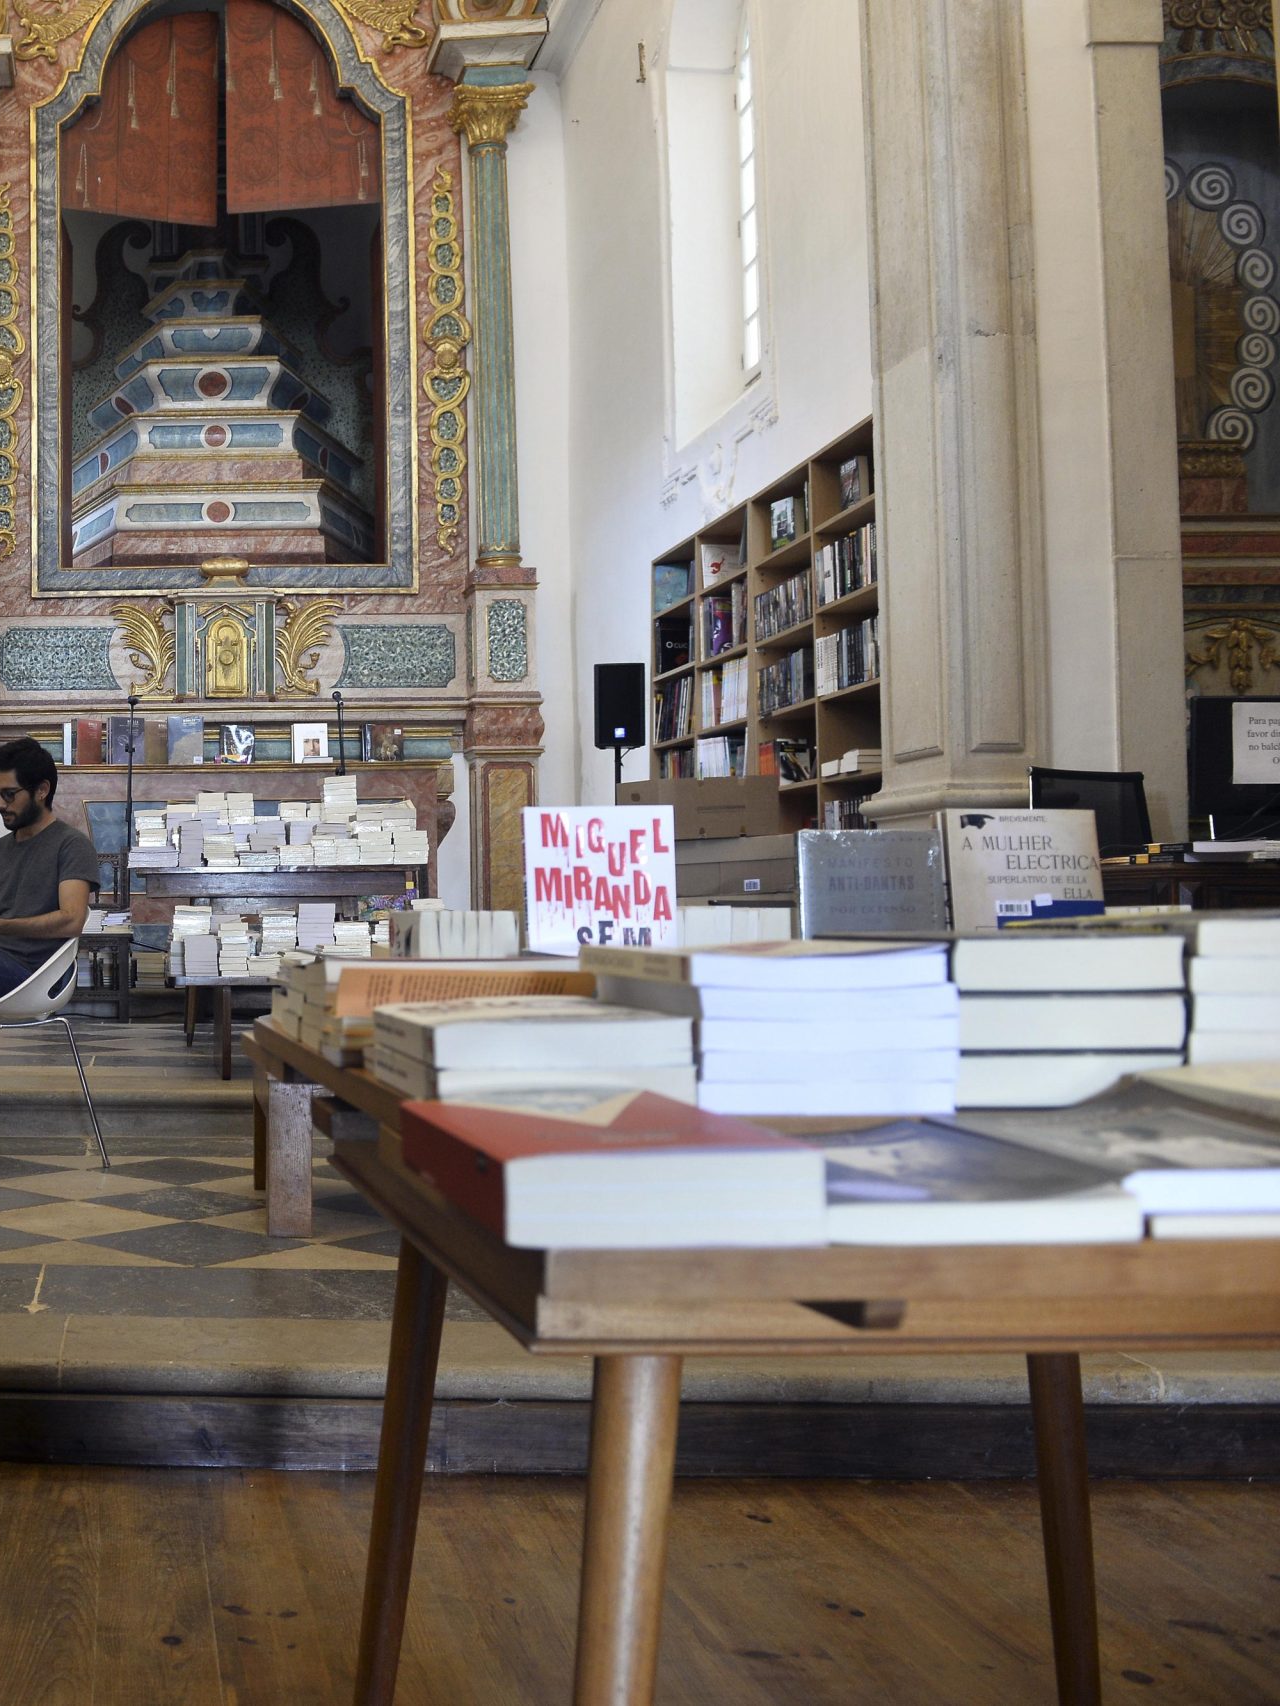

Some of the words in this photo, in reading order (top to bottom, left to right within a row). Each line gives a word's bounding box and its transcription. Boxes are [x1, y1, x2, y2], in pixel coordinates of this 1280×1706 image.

[1249, 716, 1267, 725] Para
[1247, 729, 1269, 738] favor
[540, 813, 669, 877] MIGUEL
[962, 836, 973, 851] A
[982, 835, 1053, 851] MULHER
[827, 858, 913, 868] MANIFESTO
[1006, 854, 1101, 870] ELECTRICA
[829, 875, 914, 891] ANTI-DANTAS
[987, 875, 1048, 885] SUPERLATIVO
[1051, 876, 1063, 885] DE
[1066, 876, 1087, 885] ELLA
[534, 866, 672, 921] MIRANDA
[1064, 887, 1094, 900] ELLA
